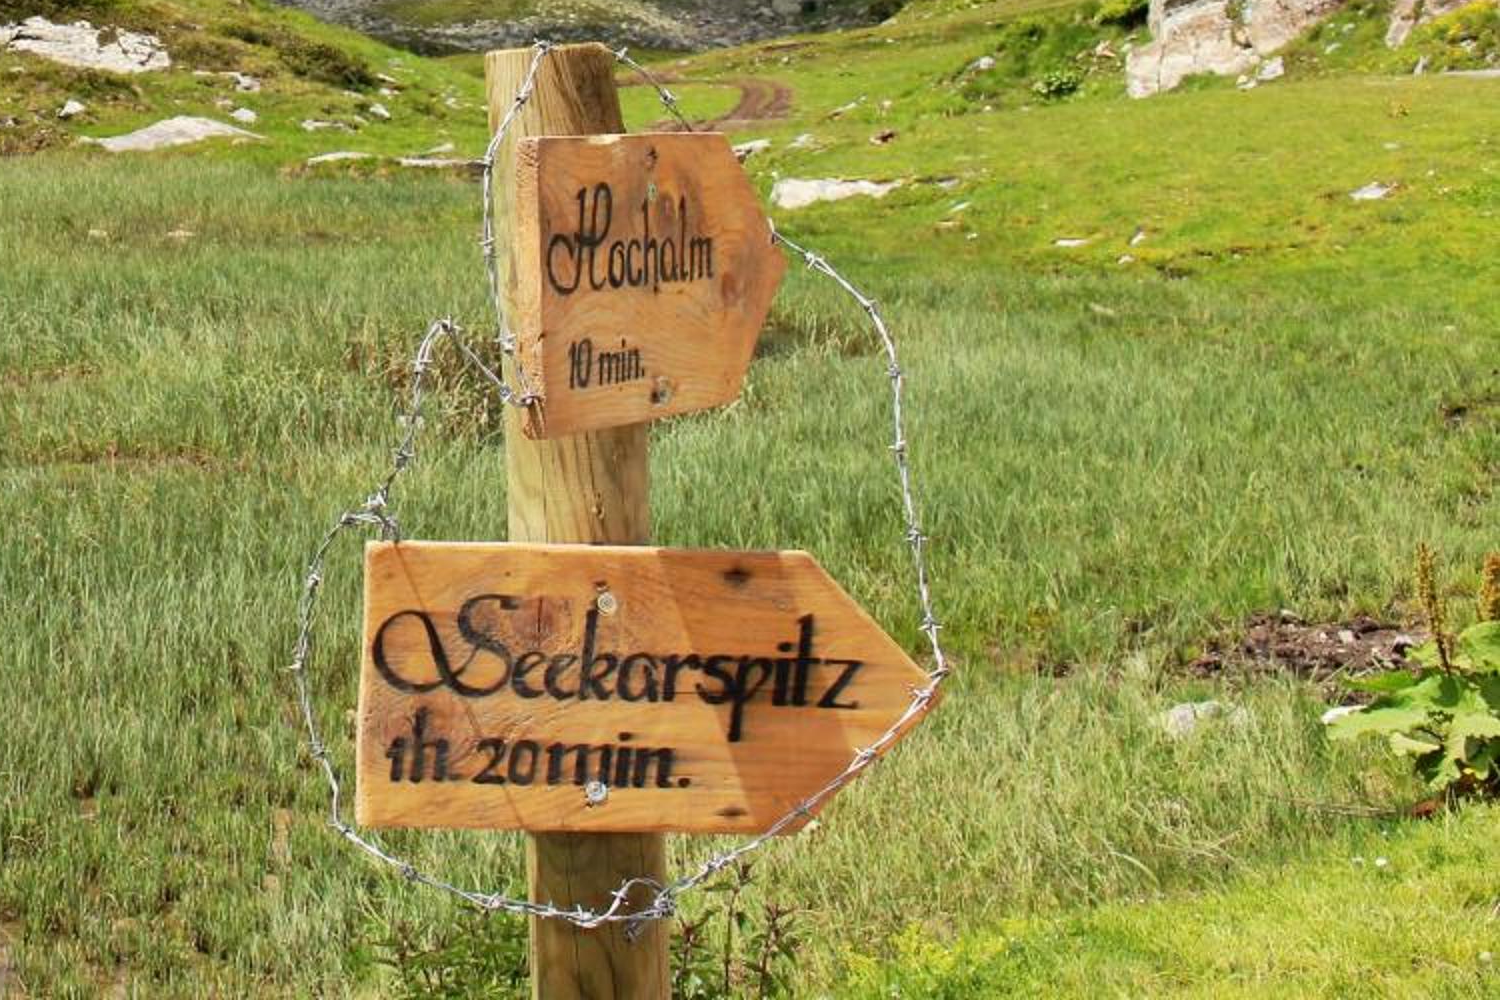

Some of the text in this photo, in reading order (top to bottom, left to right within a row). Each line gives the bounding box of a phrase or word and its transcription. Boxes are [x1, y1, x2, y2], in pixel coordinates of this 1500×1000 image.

[546, 181, 714, 295] Hochalm
[568, 337, 592, 390] 10
[371, 593, 864, 743] Seekarspitz
